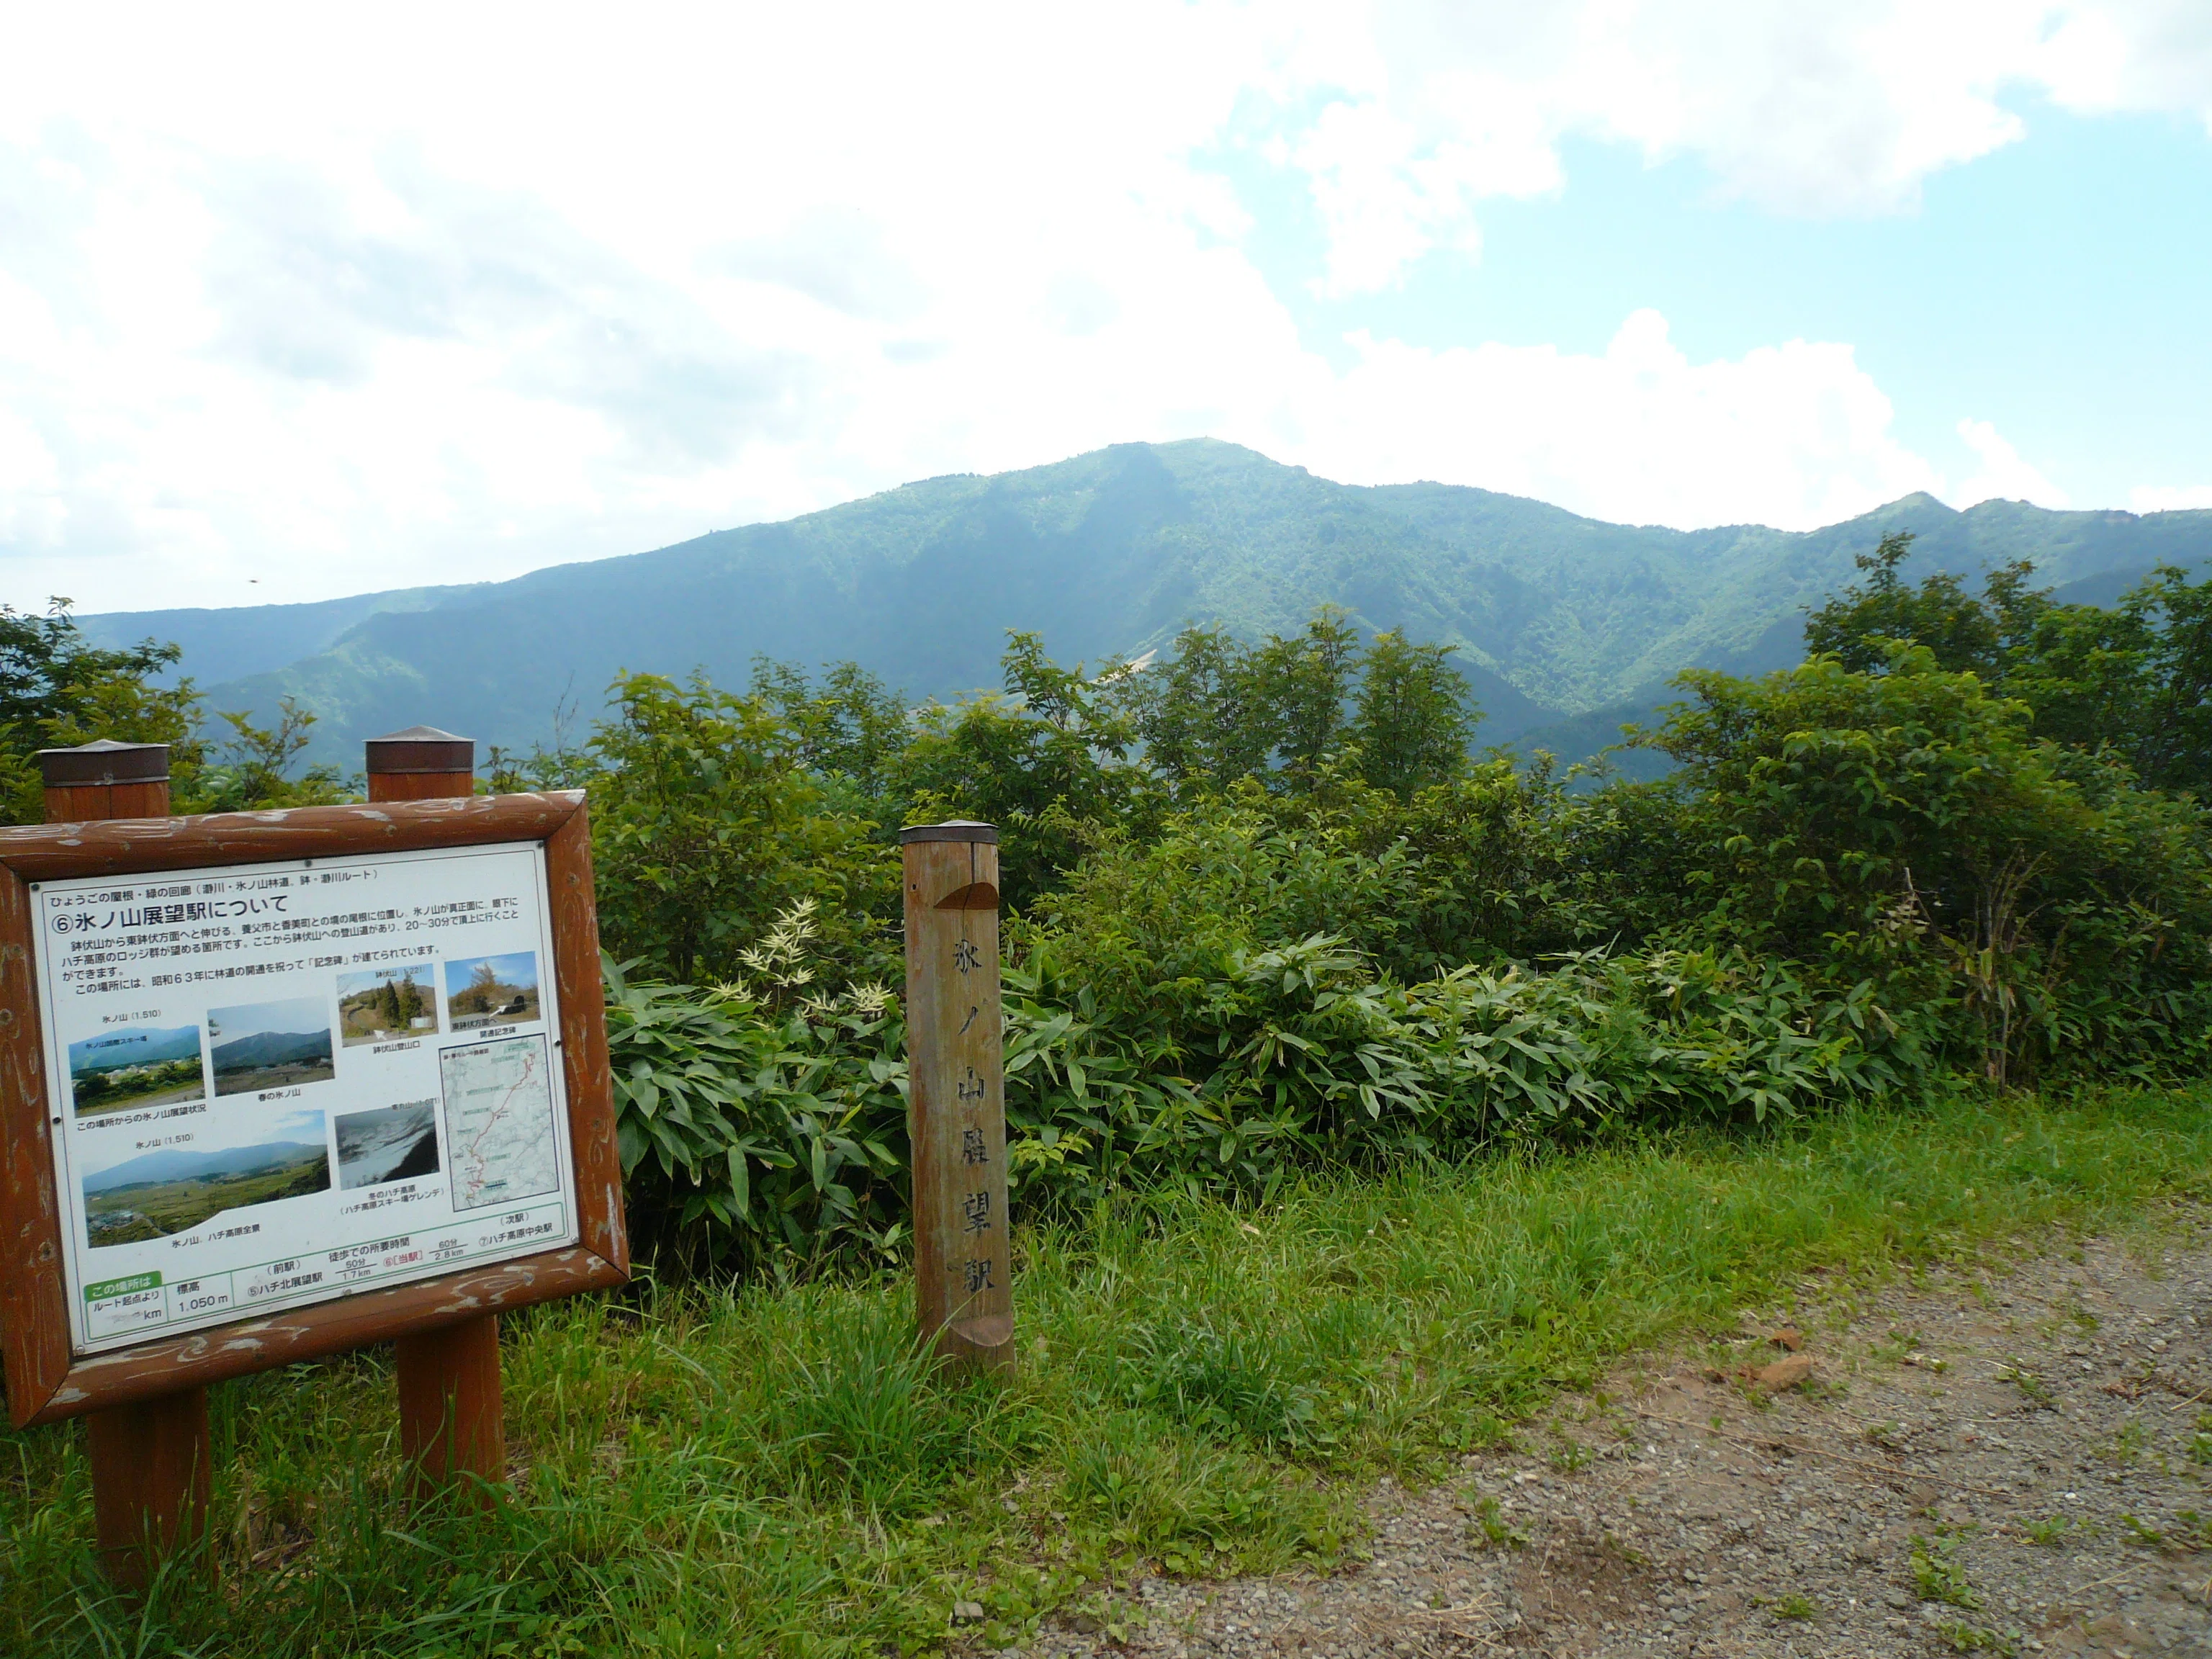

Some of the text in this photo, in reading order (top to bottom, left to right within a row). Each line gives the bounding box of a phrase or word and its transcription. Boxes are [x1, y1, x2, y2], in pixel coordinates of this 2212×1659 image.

[62, 967, 124, 982] ができます。
[373, 1040, 421, 1054] 鉢伏山登山口
[258, 1087, 301, 1102] 春の氷ノ山
[77, 1104, 207, 1131] この場所からの氷ノ山展望状況
[953, 938, 994, 1294] 氷ノ山展望駅
[368, 1184, 416, 1200] 冬のハチ高原
[328, 1236, 410, 1263] 徒歩での所要時間
[92, 1276, 152, 1298] この場所は
[176, 1281, 200, 1295] 標高
[93, 1290, 160, 1313] ルート起点より
[143, 1308, 163, 1321] km
